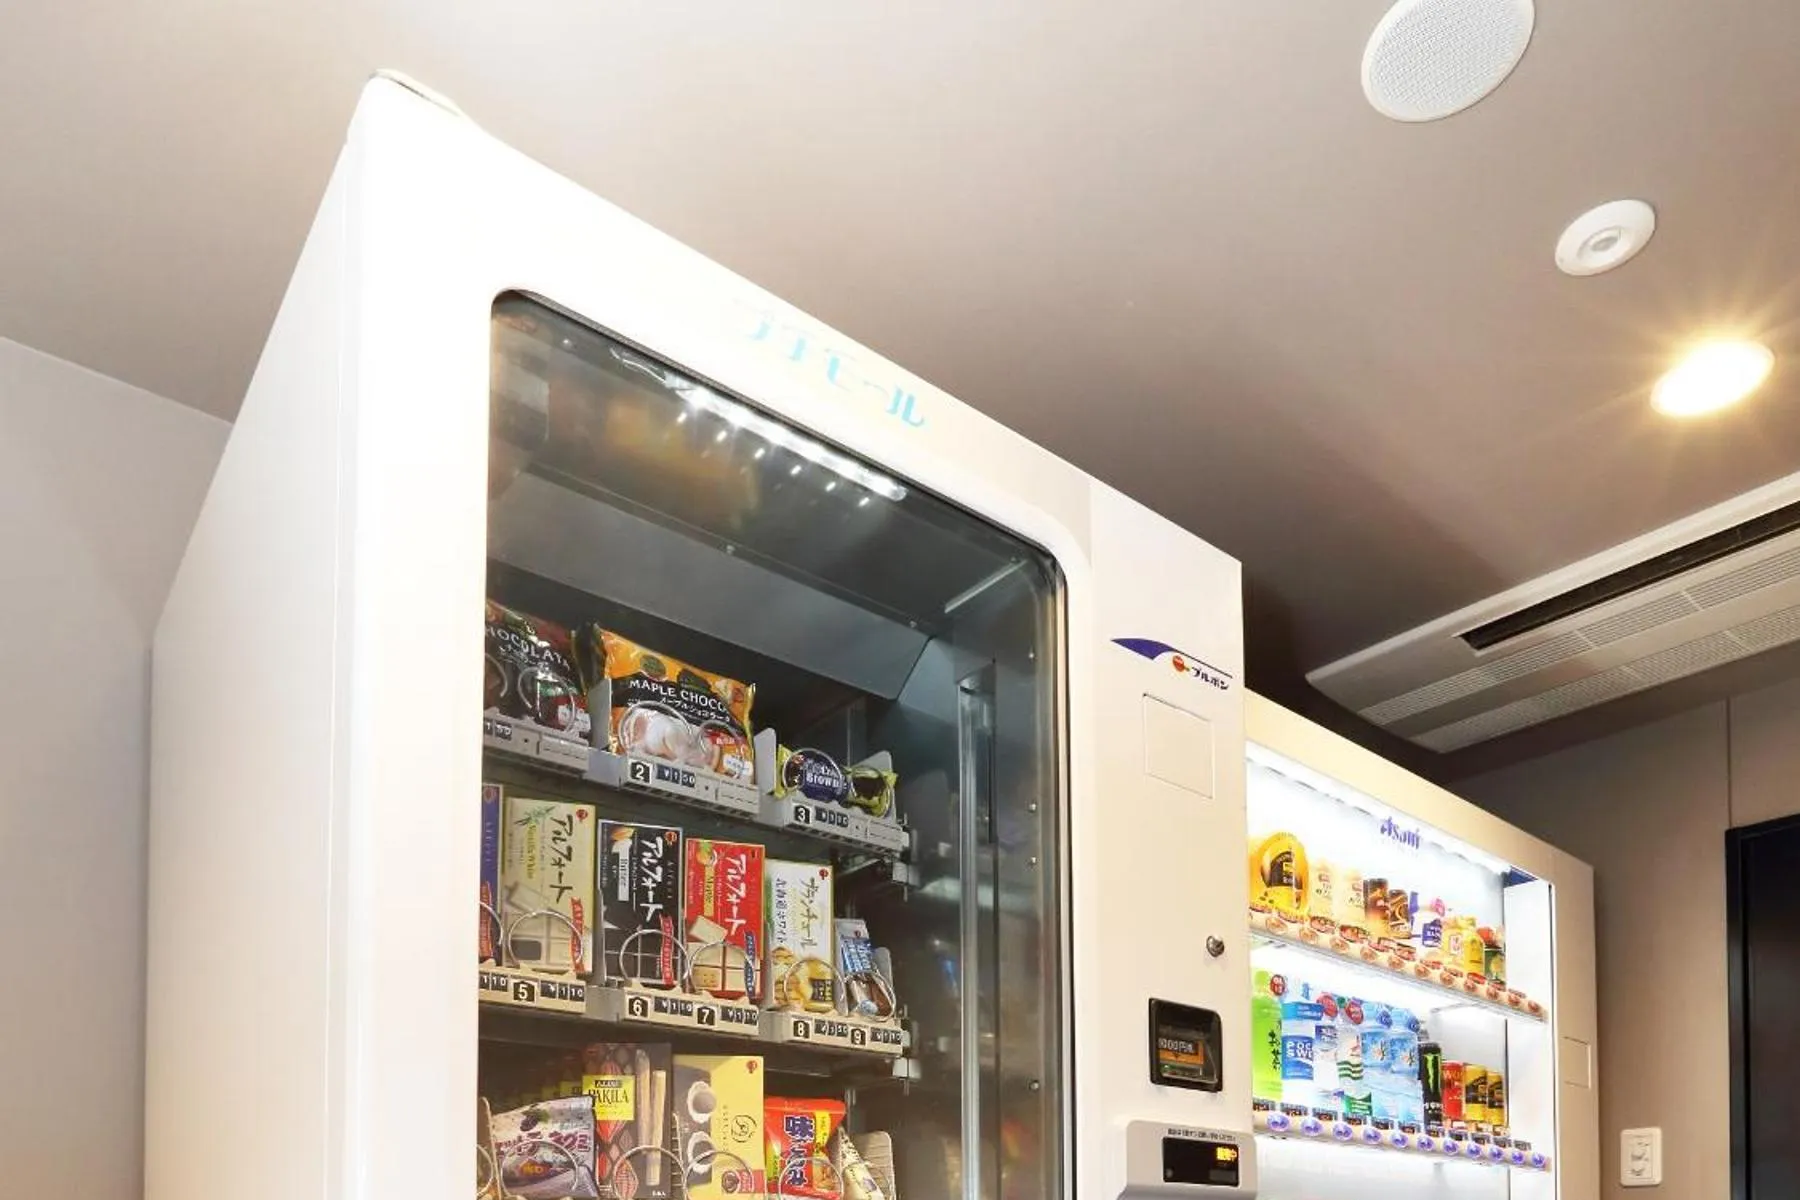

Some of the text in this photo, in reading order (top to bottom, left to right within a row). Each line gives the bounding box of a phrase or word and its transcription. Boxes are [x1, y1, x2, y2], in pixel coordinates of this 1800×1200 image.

[1191, 666, 1230, 690] ブルボン
[629, 679, 677, 698] MAPLE
[635, 763, 645, 780] 2
[797, 807, 806, 821] 3
[549, 813, 573, 904] アルフォート
[640, 835, 663, 923] アルフォート
[724, 853, 747, 936] アルフォート
[519, 984, 529, 998] 5
[633, 1000, 643, 1014] 6
[702, 1009, 711, 1022] 7
[796, 1023, 806, 1036] 8
[854, 1031, 862, 1044] 9
